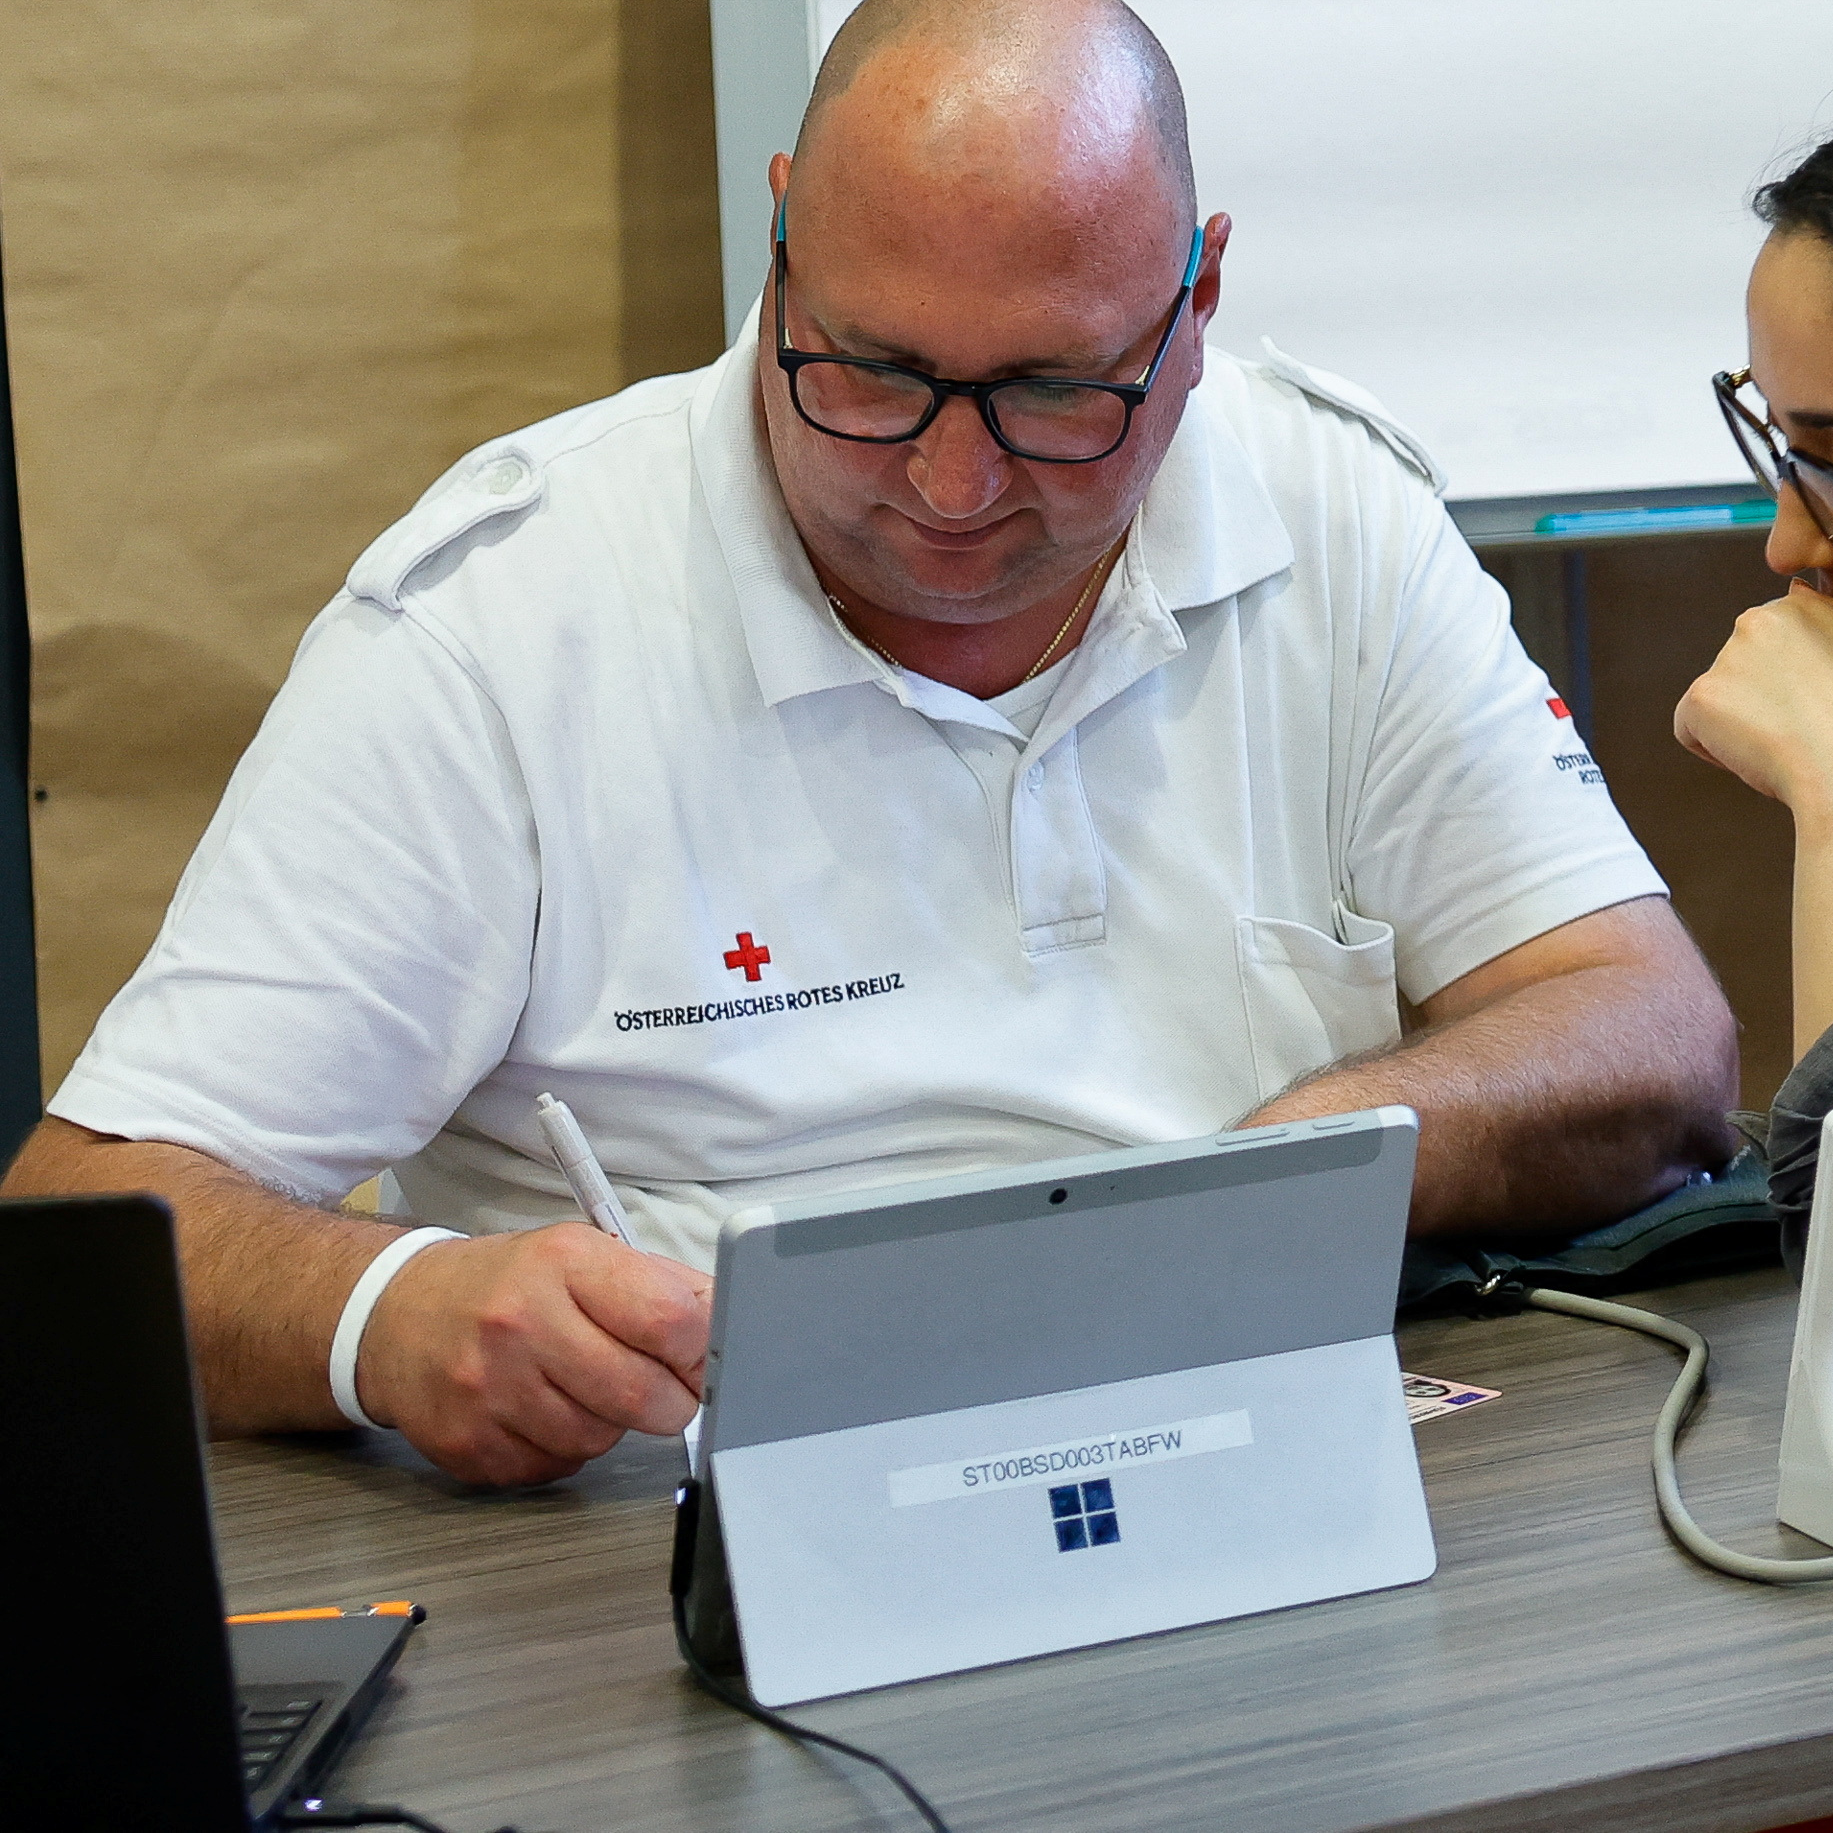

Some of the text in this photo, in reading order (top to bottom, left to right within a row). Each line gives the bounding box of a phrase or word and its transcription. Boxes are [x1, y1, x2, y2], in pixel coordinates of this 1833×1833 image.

[615, 973, 905, 1031] ÖSTERREICHISCHES ROTES KREUZ
